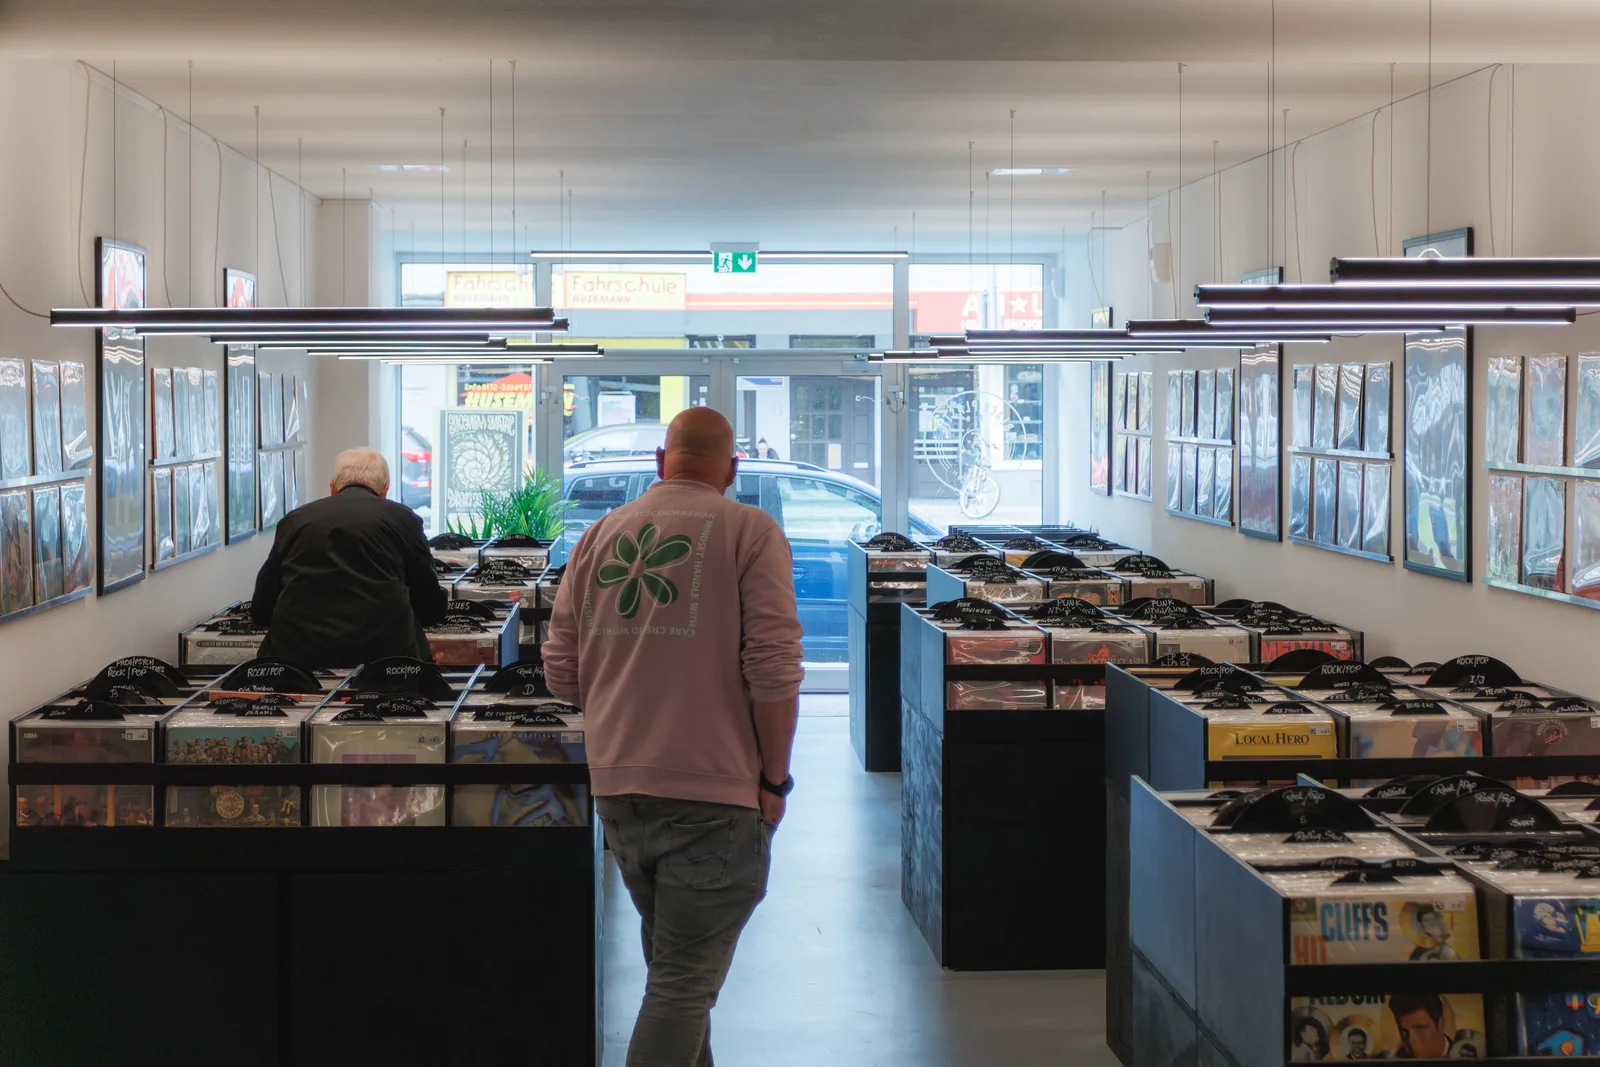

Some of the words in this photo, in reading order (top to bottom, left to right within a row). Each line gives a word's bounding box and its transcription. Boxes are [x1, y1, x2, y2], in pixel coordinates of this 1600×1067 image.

[572, 274, 678, 295] Fahrschule
[572, 295, 632, 304] HUSEMANN
[464, 391, 533, 409] HUSEM
[695, 518, 716, 559] MINDSET
[690, 562, 704, 600] HANDLE
[1057, 599, 1083, 607] PUNK
[1150, 599, 1175, 608] PUNK
[687, 603, 700, 627] WITH
[669, 626, 696, 637] CARE
[1260, 639, 1351, 663] MELVINS
[1456, 655, 1490, 668] ROCK/POP
[246, 666, 285, 677] ROCK/POP
[386, 665, 421, 680] ROCK/POP
[1199, 666, 1235, 679] ROCK/POP
[1320, 664, 1363, 676] ROCK/POP
[1469, 674, 1486, 685] I/J
[109, 688, 119, 699] B
[521, 683, 536, 696] D
[83, 703, 94, 713] A
[1235, 732, 1275, 746] LOCAL
[1276, 732, 1310, 746] HERO
[1299, 815, 1308, 825] S
[1293, 935, 1328, 964] HIT
